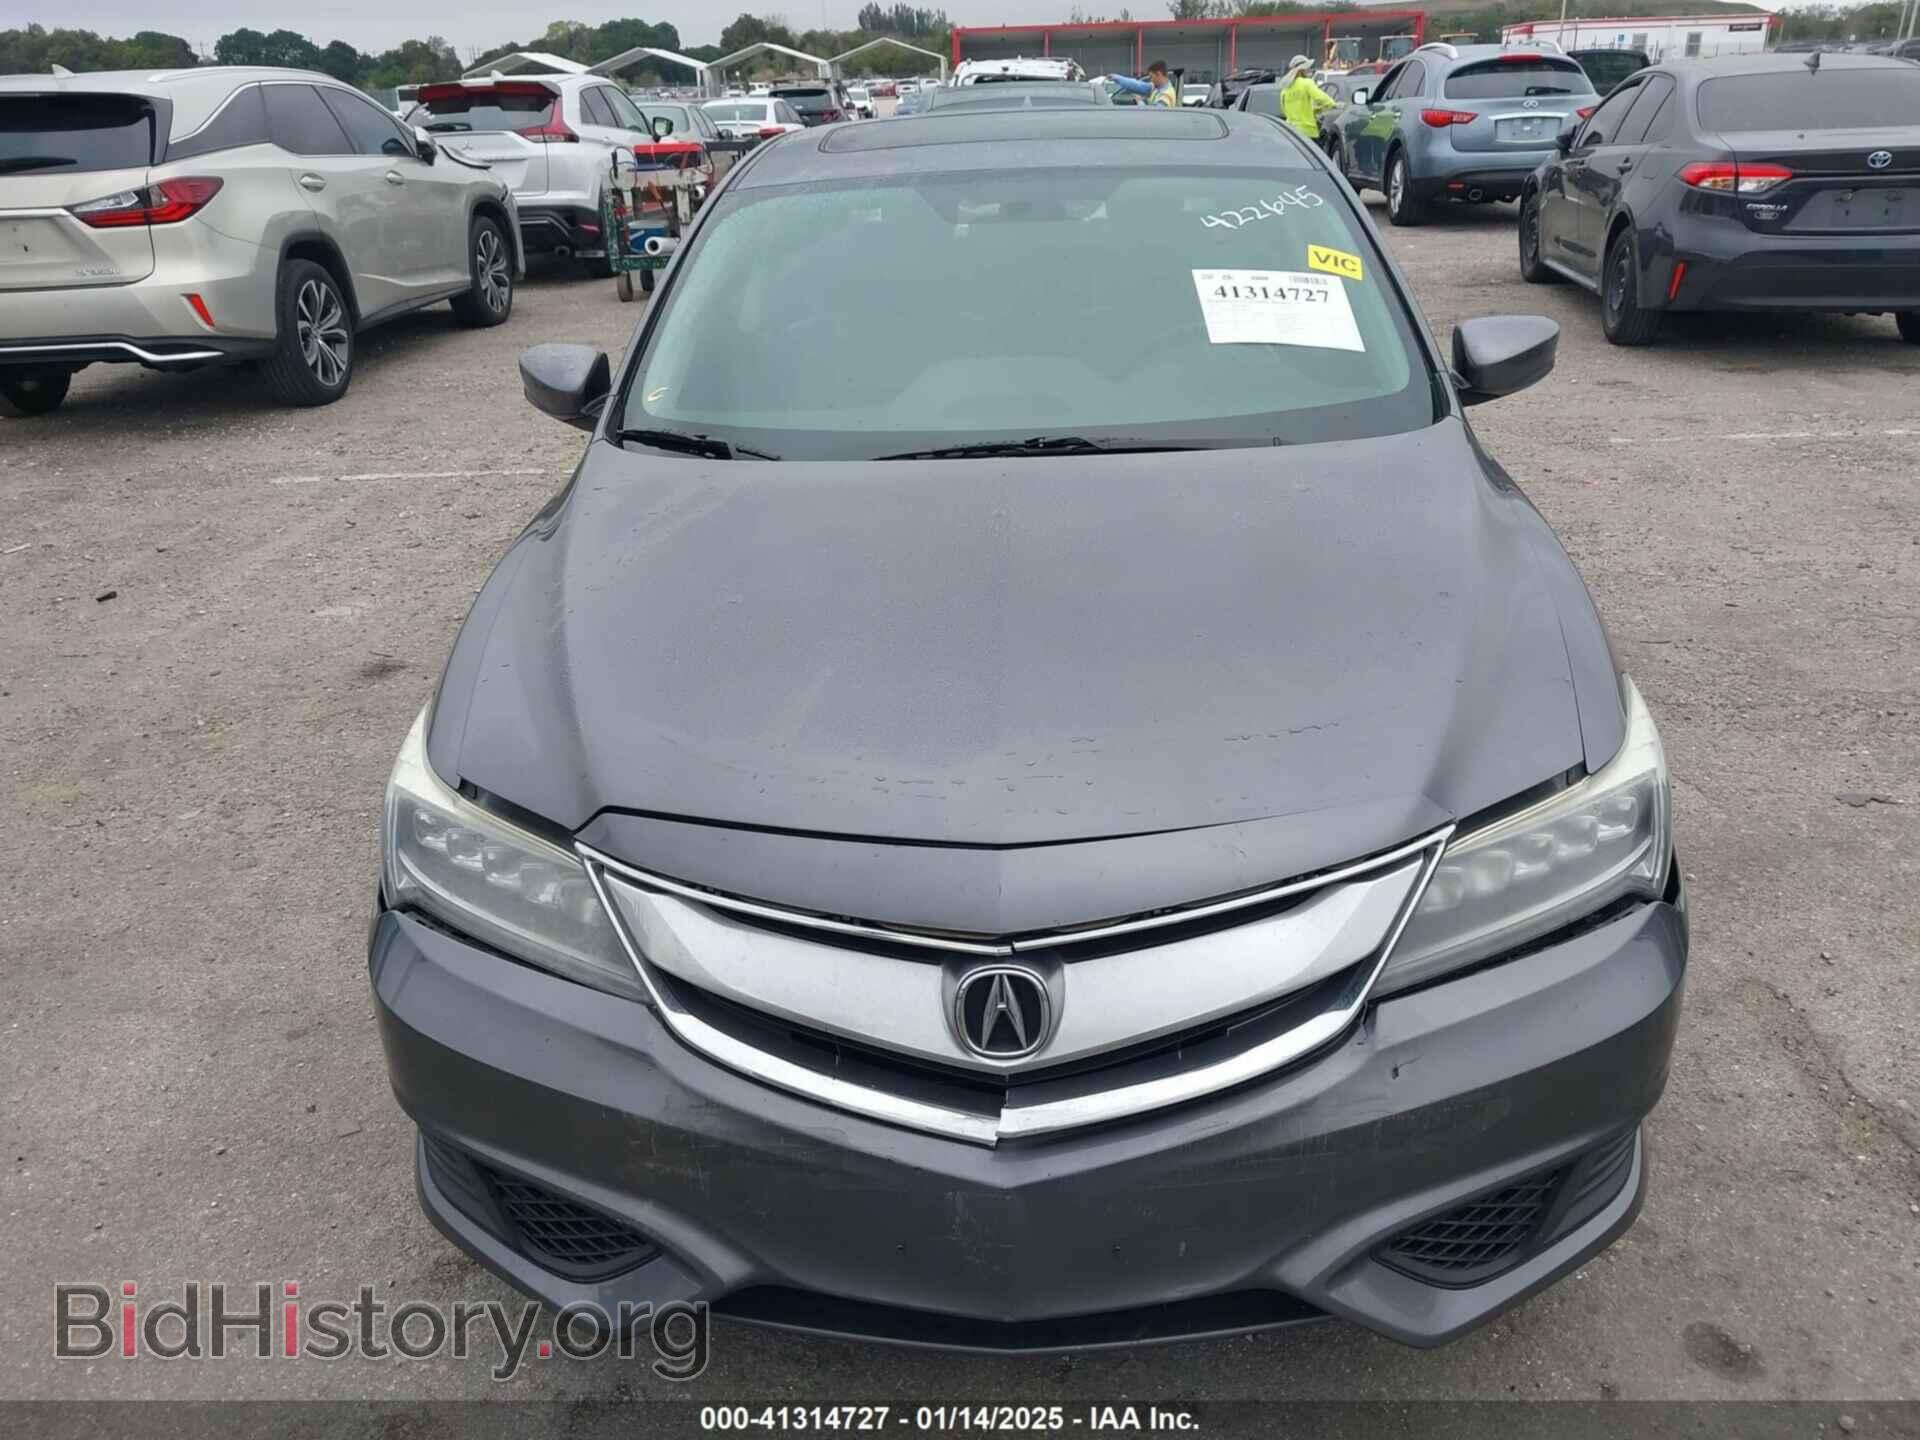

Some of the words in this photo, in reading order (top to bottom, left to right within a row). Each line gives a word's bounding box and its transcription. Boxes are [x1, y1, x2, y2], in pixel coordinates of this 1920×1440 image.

[1200, 185, 1324, 230] 422645
[1312, 250, 1358, 272] VIC
[1214, 285, 1329, 303] 41314727
